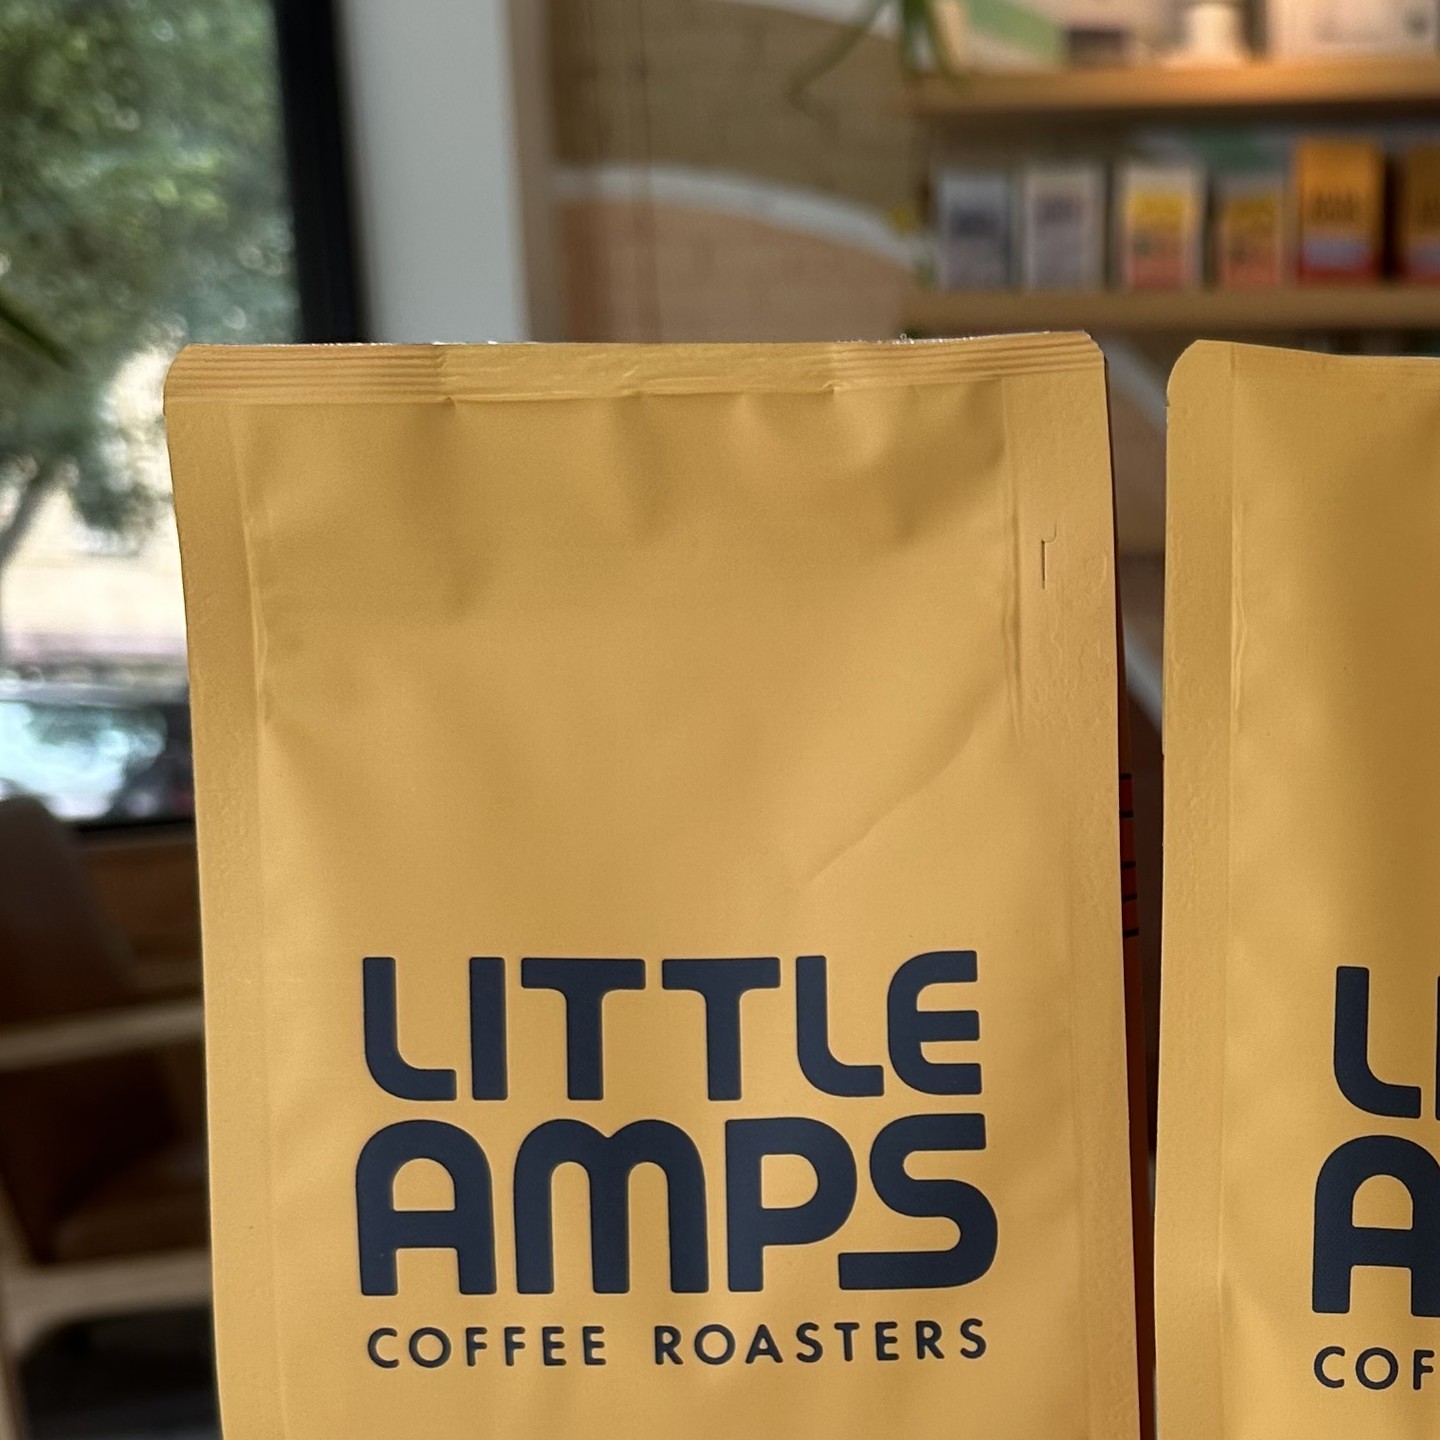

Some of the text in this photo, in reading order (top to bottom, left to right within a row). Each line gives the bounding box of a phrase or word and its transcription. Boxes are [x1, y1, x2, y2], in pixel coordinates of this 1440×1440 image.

[362, 950, 982, 1101] LITTLE
[355, 1113, 998, 1296] AMPS
[367, 1318, 986, 1368] COFFEE ROASTERS
